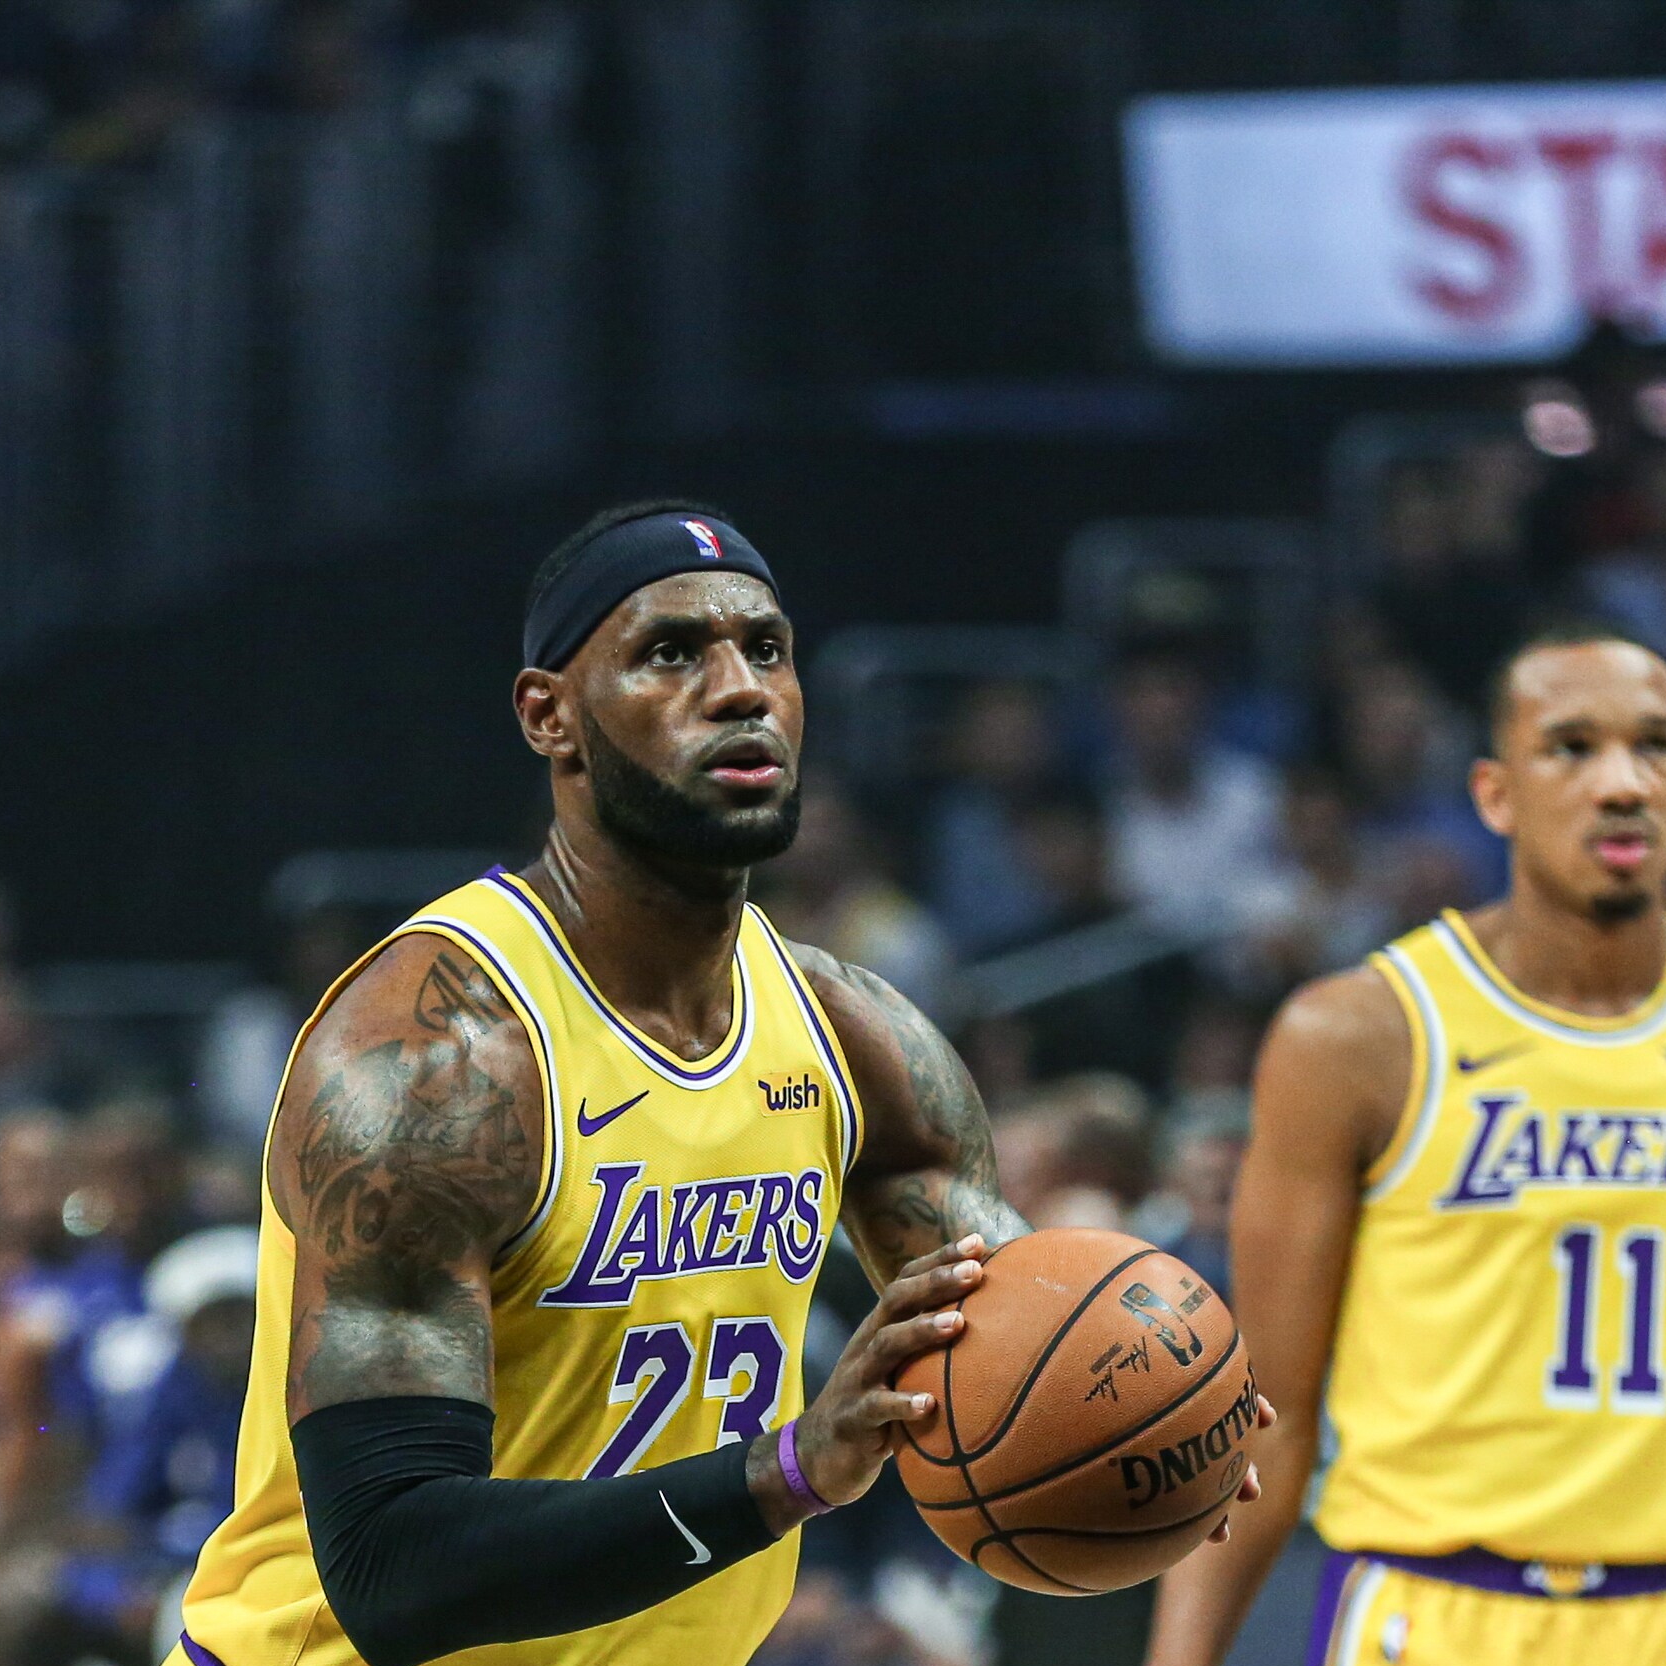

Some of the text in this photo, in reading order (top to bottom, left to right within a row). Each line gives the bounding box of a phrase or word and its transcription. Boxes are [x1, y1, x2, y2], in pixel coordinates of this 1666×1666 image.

[757, 1072, 821, 1112] wish
[536, 1160, 825, 1309] LAKERS
[581, 1316, 788, 1475] 23
[1120, 1358, 1259, 1510] PALDING
